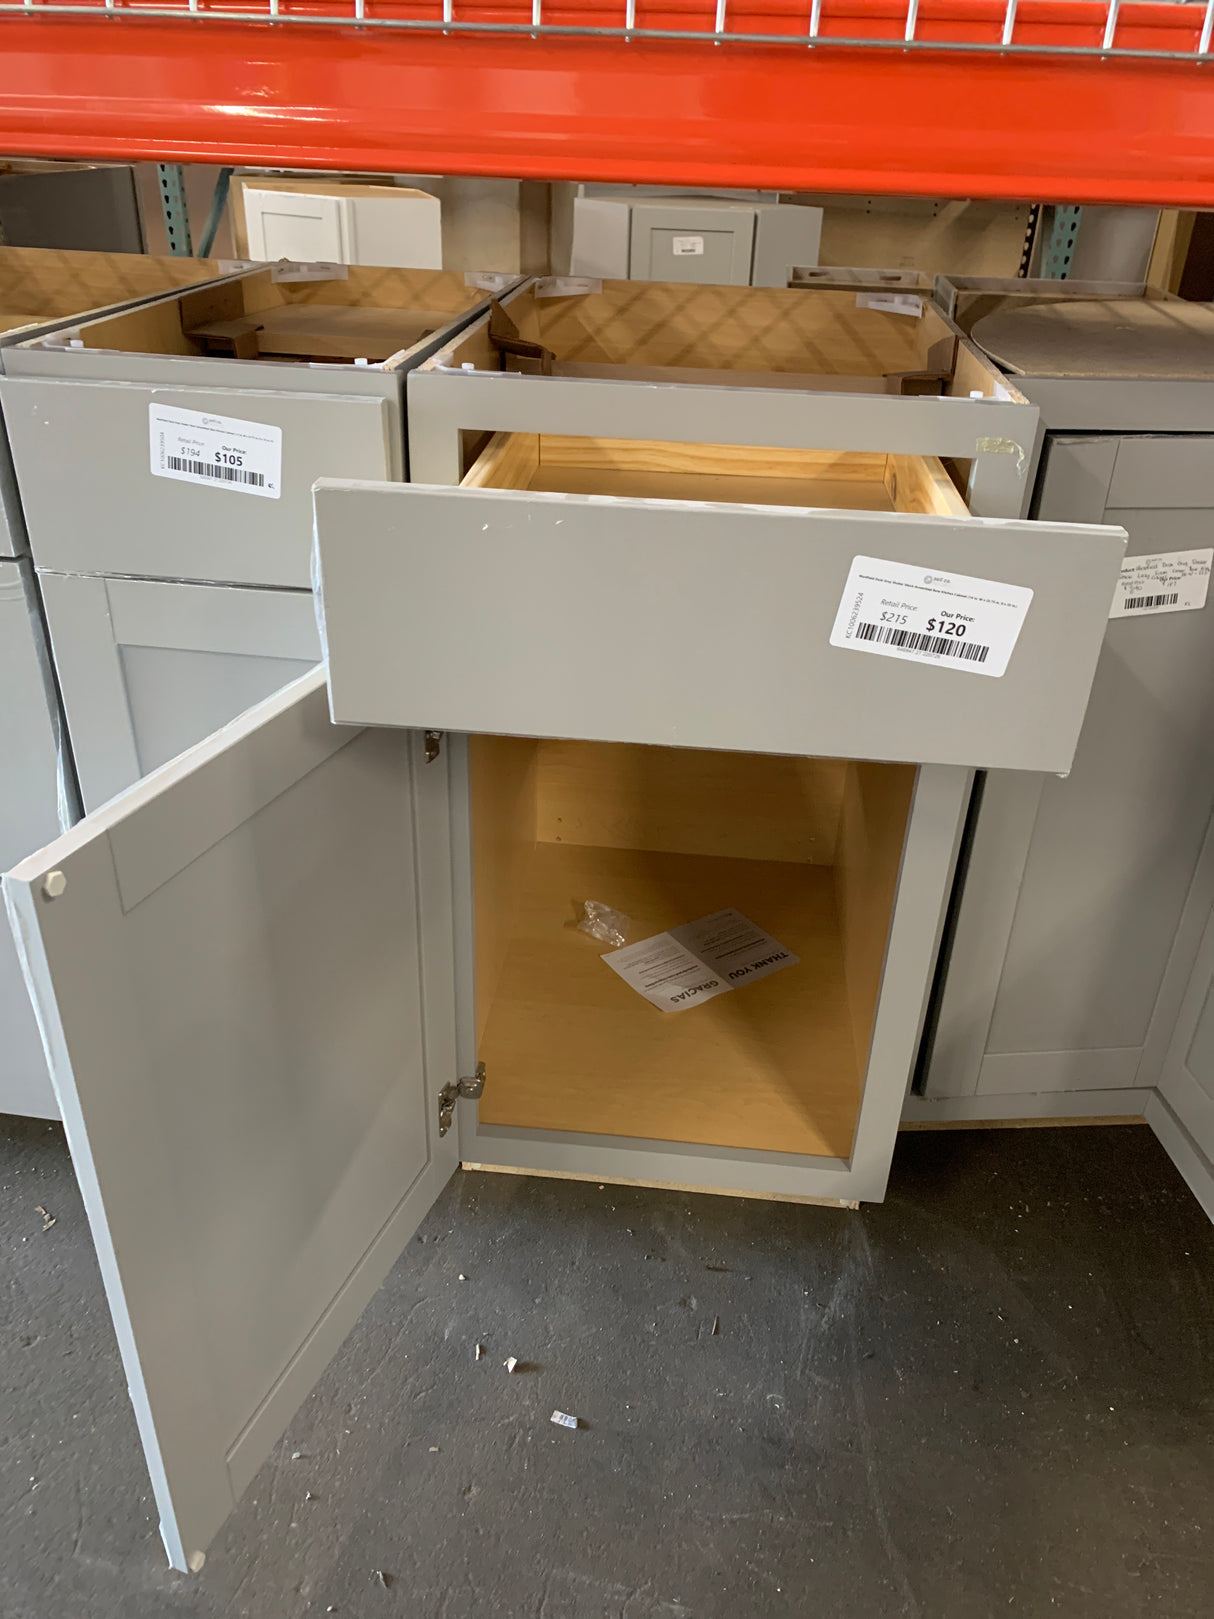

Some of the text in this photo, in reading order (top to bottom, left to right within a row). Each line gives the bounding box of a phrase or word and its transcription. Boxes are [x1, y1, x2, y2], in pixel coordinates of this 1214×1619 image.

[180, 446, 201, 457] $194
[214, 451, 243, 467] $105
[880, 598, 900, 610] Retail
[880, 611, 908, 625] $215
[940, 610, 976, 623] Our Price:
[926, 617, 966, 637] $120
[728, 951, 789, 980] THANK YOU
[670, 979, 719, 1004] GRACIAS
